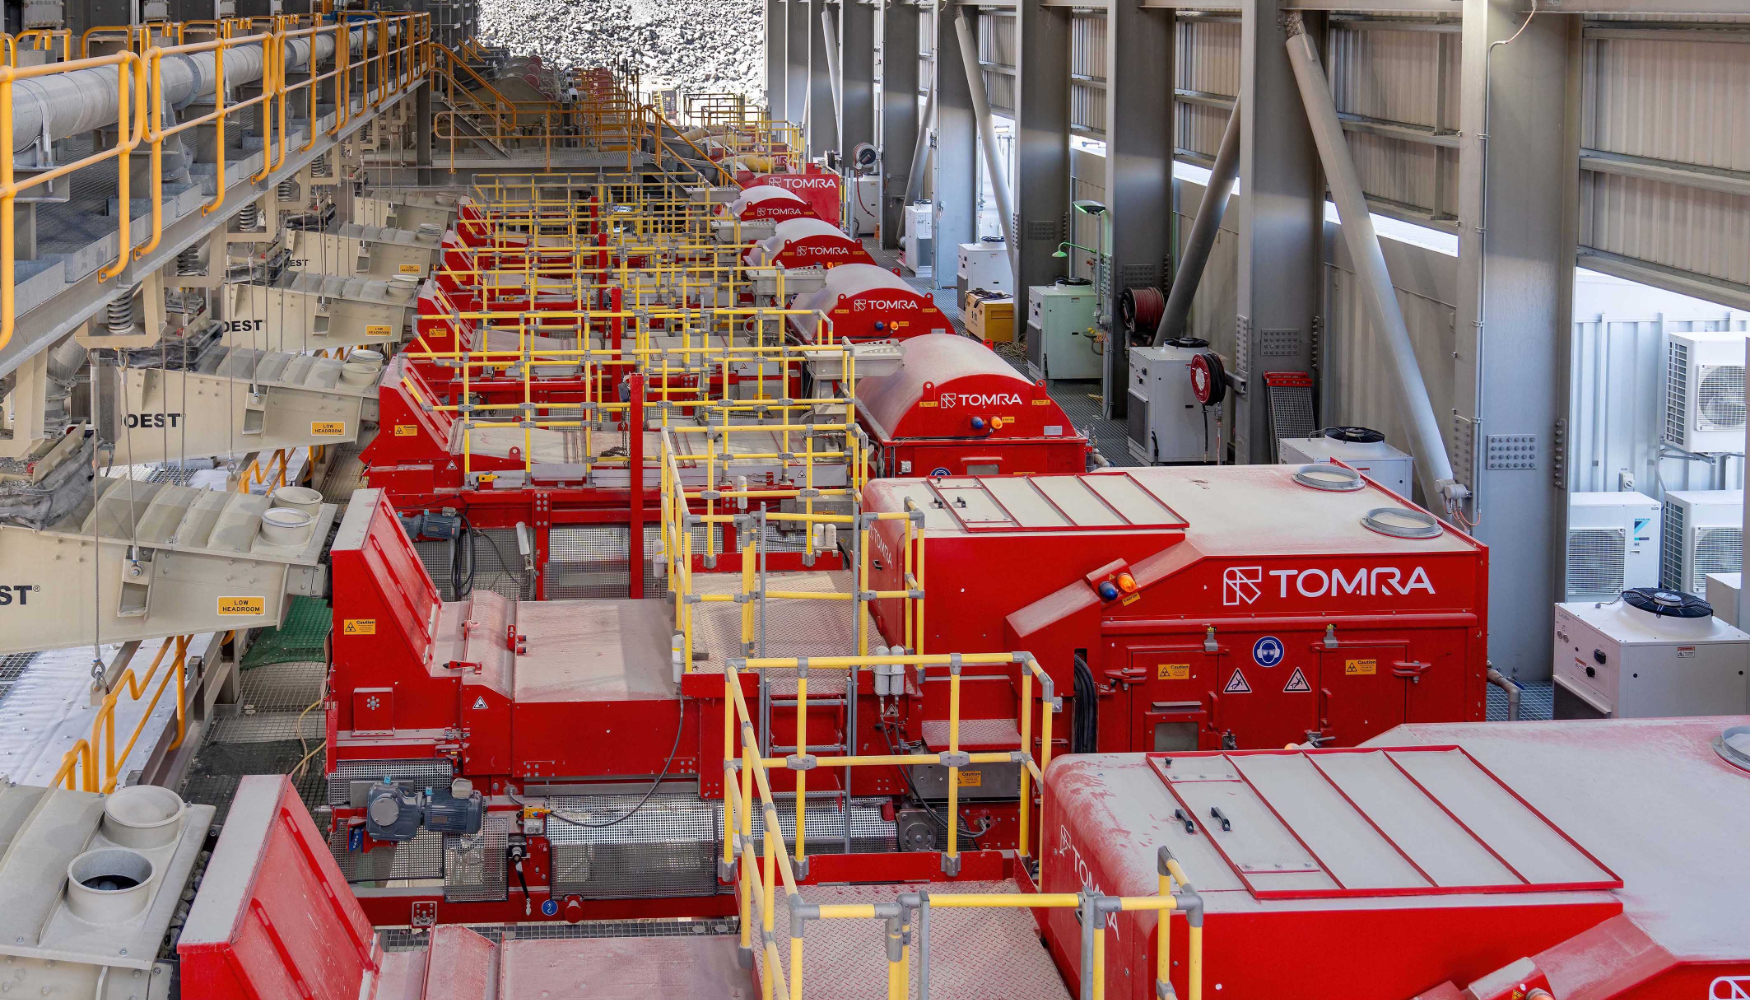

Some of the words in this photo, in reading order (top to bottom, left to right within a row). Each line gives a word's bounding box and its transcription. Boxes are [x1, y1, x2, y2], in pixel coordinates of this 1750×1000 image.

[783, 179, 836, 188] TOMRA
[808, 247, 849, 255] TOMRA
[868, 300, 918, 309] TOMRA
[958, 393, 1022, 406] TOMRA
[873, 527, 893, 570] TOMRA
[1268, 566, 1436, 598] TOMRA
